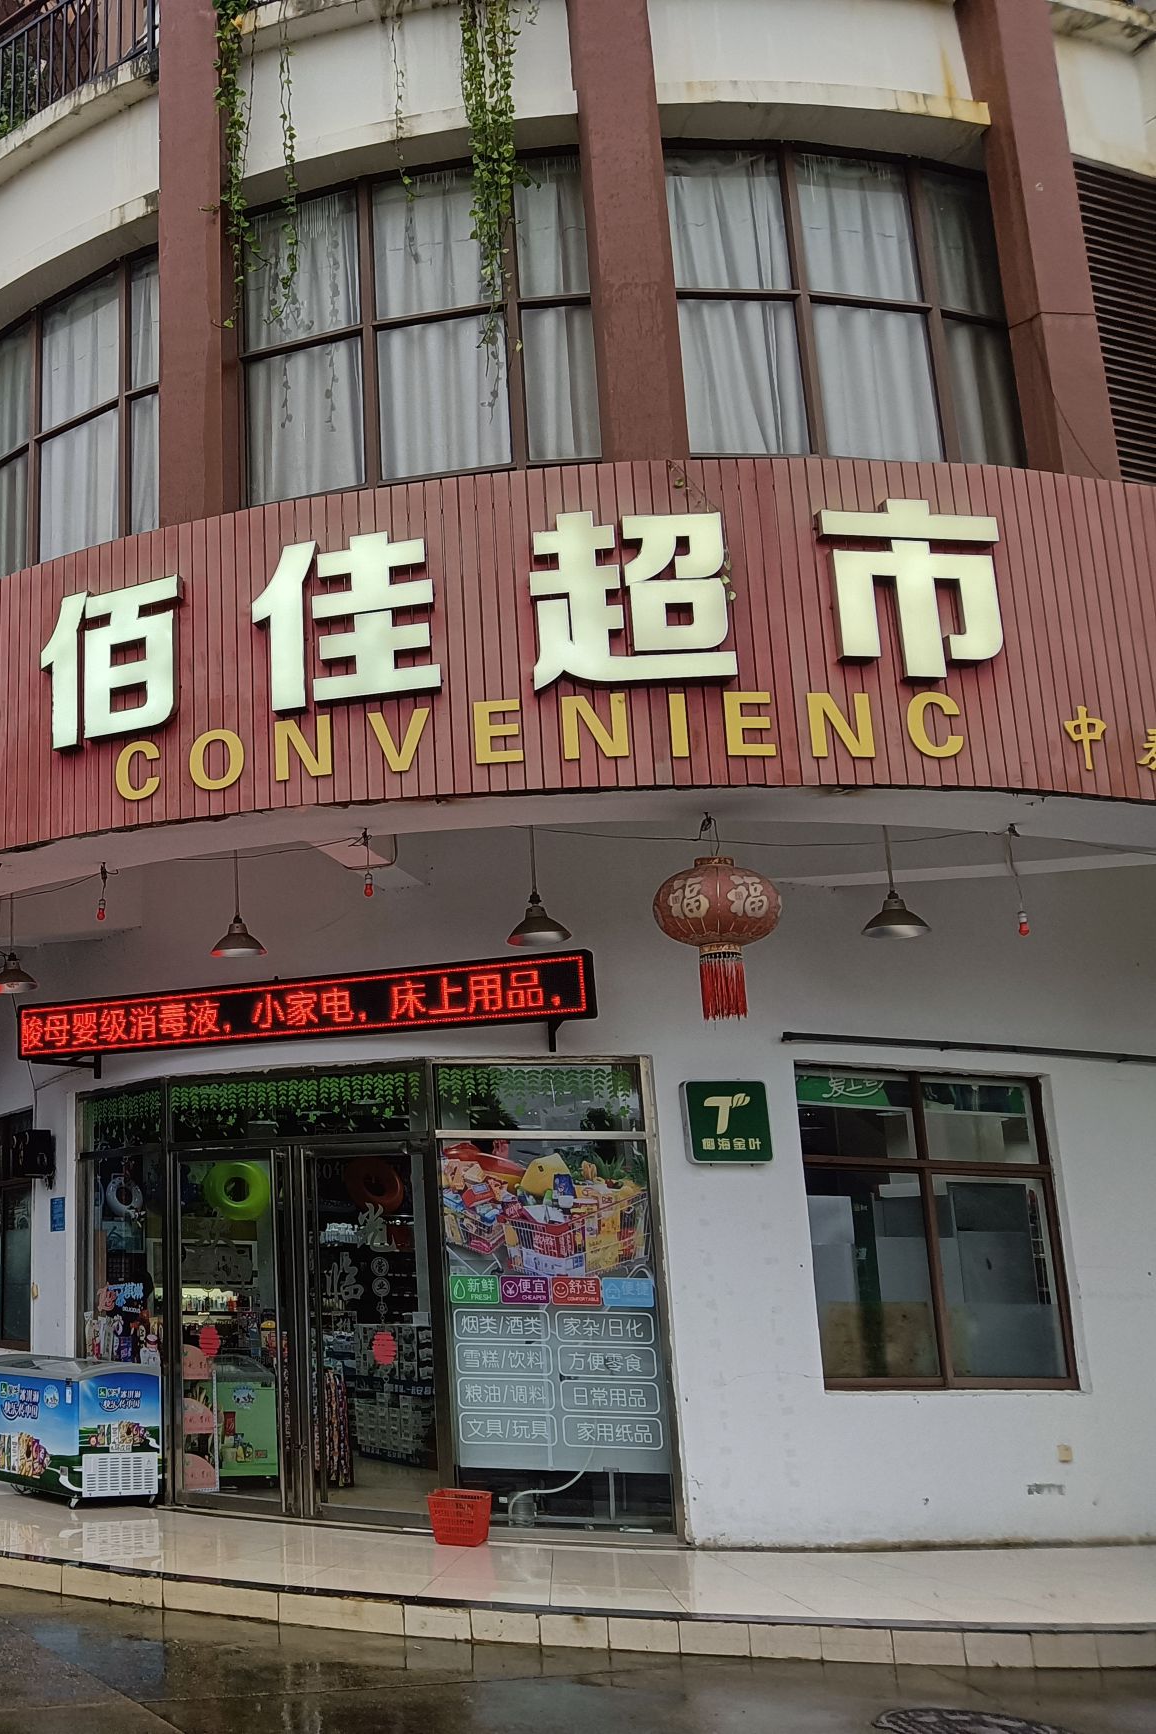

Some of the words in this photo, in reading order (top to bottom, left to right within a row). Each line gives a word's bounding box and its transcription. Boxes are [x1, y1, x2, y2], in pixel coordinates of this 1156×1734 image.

[40, 498, 1004, 752] 佰佳超市
[115, 691, 965, 801] CONVENIENC
[666, 876, 709, 920] 福
[726, 875, 769, 918] 福
[467, 1278, 495, 1293] 新鲜
[518, 1278, 546, 1294] 便宜
[568, 1280, 597, 1295] 舒适
[461, 1315, 543, 1335] 烟类/酒类
[563, 1318, 644, 1338] 家杂/日化
[463, 1350, 544, 1370] 雪糕/饮料
[568, 1353, 643, 1373] 方便零食
[465, 1384, 547, 1405] 粮油/调料
[573, 1387, 647, 1408] 日常用品
[466, 1419, 549, 1439] 文具/玩具
[576, 1422, 653, 1443] 家用纸品
